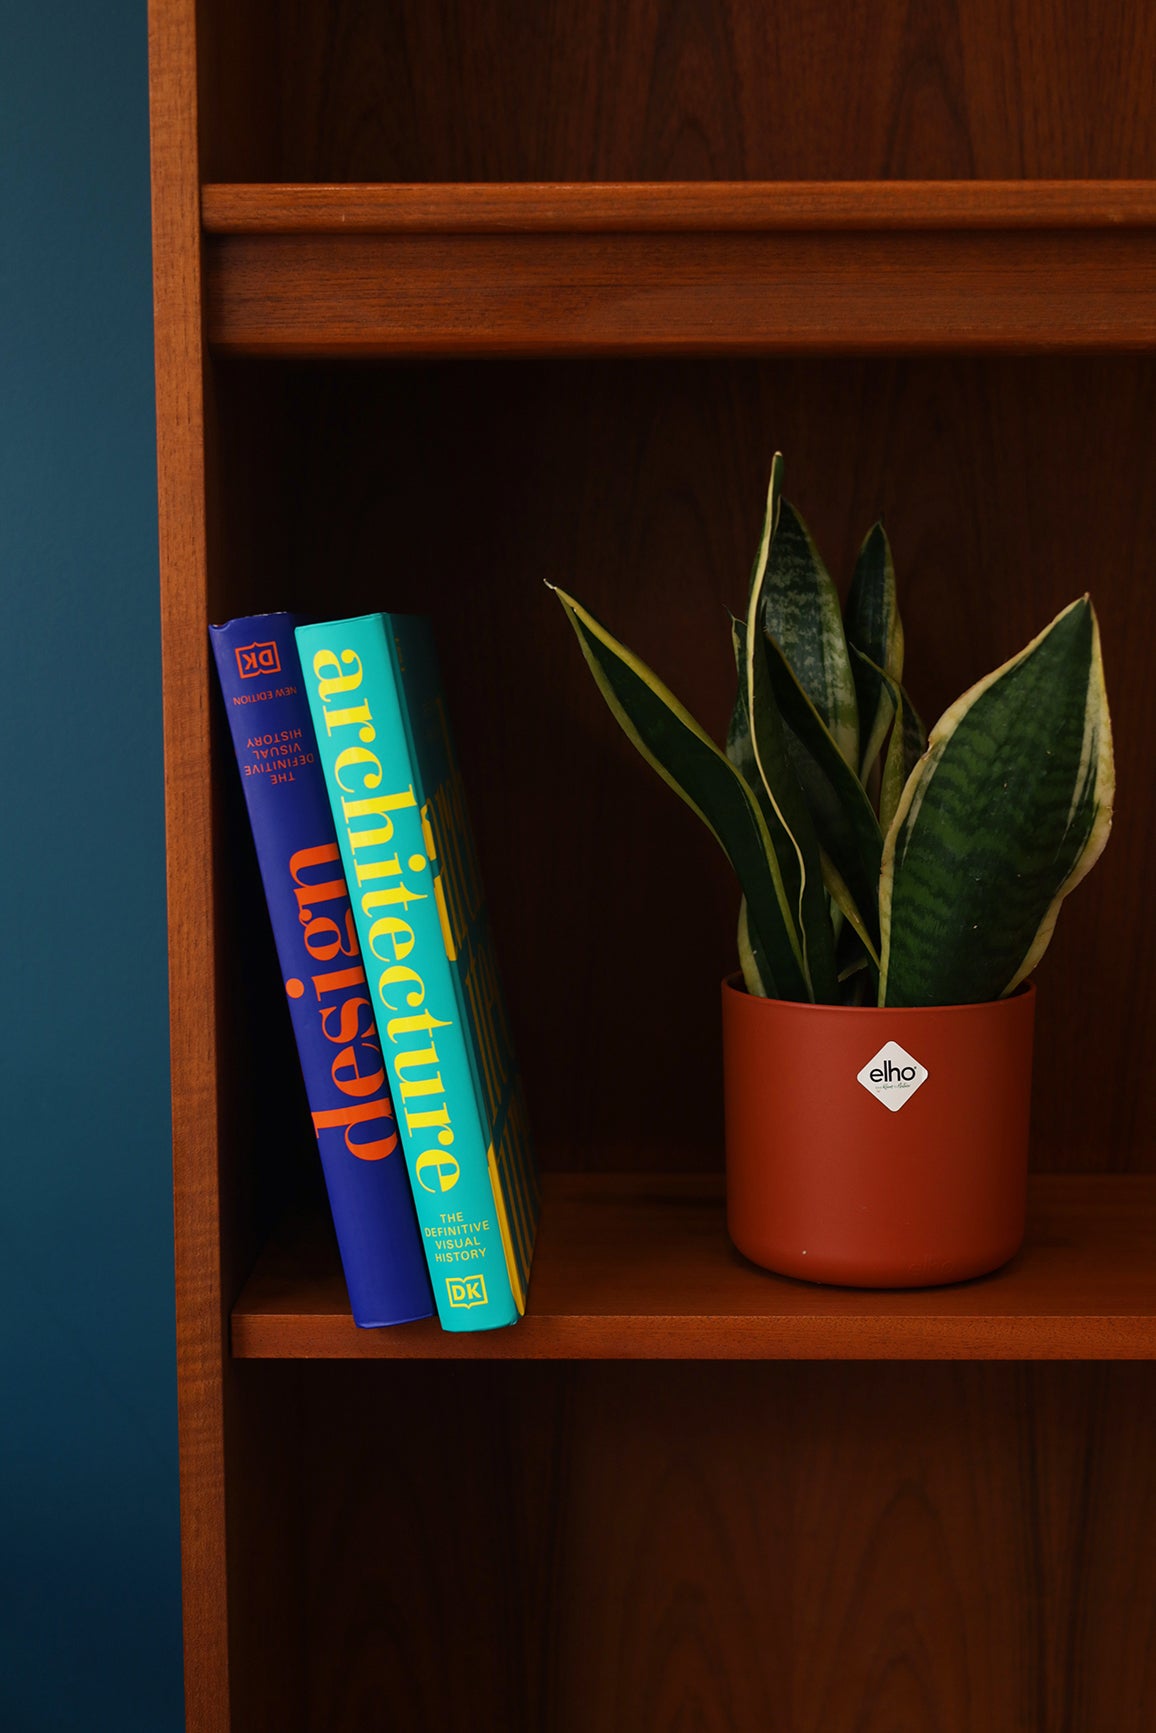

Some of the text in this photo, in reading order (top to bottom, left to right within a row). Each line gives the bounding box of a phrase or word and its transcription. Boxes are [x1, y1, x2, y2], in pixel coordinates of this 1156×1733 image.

[241, 649, 275, 671] DK
[233, 687, 297, 705] NEW EDITION
[247, 729, 303, 749] HISTORY
[252, 743, 302, 760] VISUAL
[244, 753, 314, 776] DEFINITIVE
[270, 772, 297, 785] THE
[313, 648, 461, 1193] architecture
[284, 842, 398, 1161] design
[869, 1060, 916, 1083] elho
[440, 1212, 464, 1224] THE
[424, 1220, 490, 1237] DEFINITIVE
[435, 1237, 480, 1250] VISUAL
[435, 1248, 487, 1263] HISTORY
[451, 1282, 482, 1301] DK
